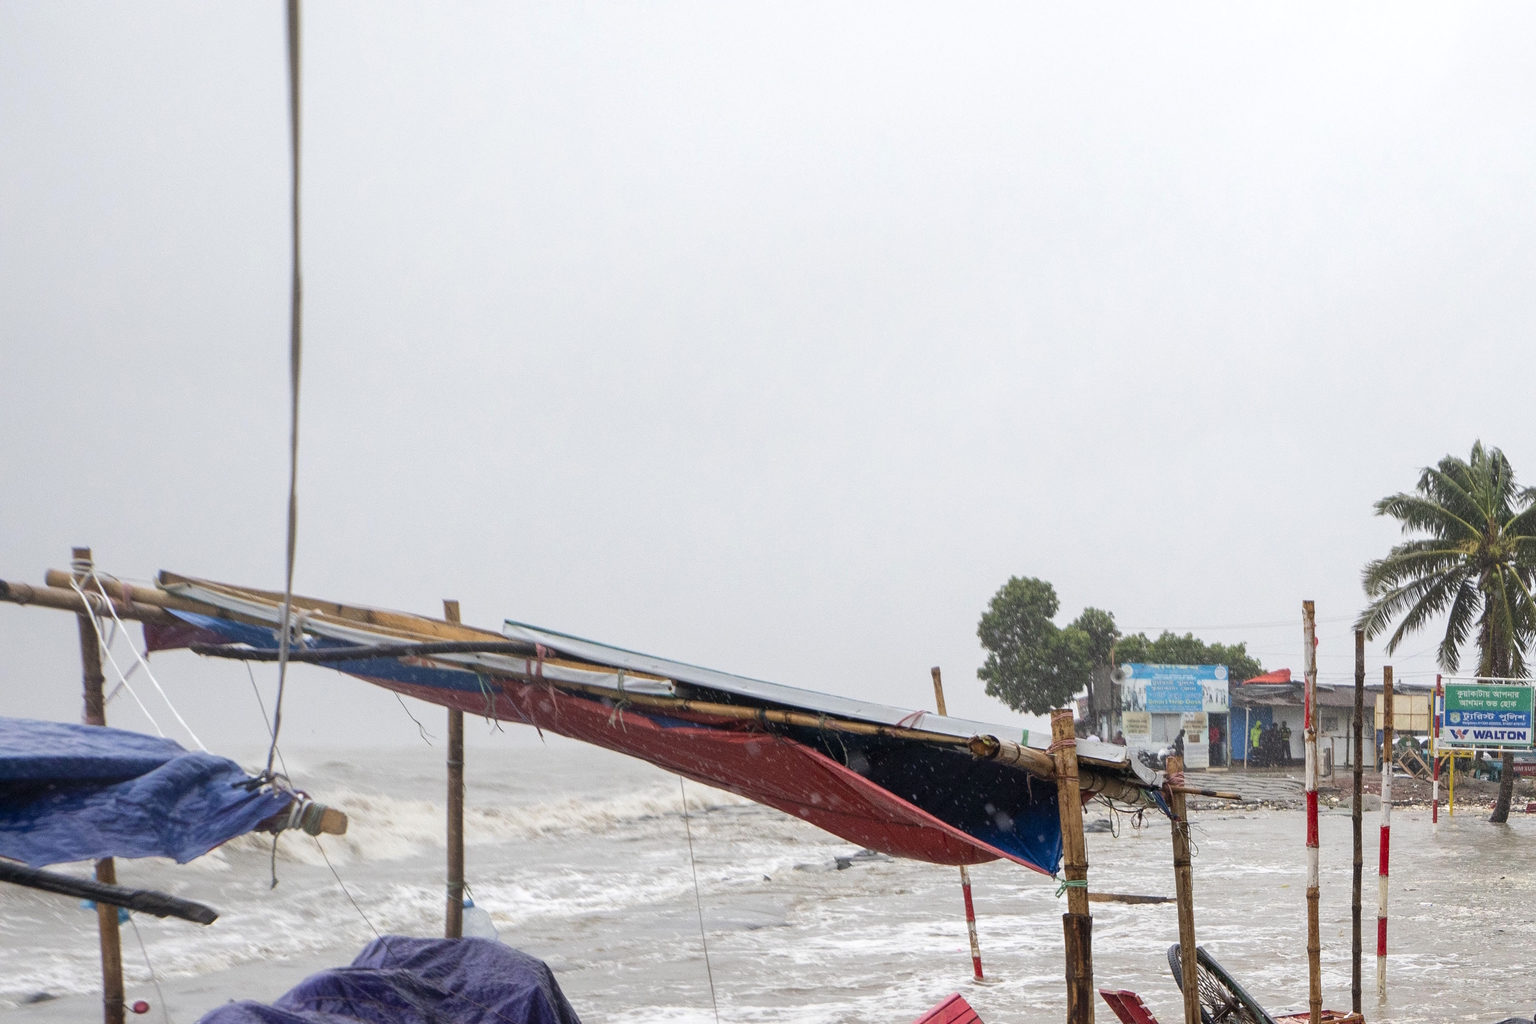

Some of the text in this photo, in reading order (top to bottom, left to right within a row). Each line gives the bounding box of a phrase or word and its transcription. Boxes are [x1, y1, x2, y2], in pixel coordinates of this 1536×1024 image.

[1492, 690, 1520, 699] আপনার
[1459, 699, 1484, 707] আগমন
[1500, 700, 1517, 708] হোক
[1462, 711, 1526, 722] ট্যুরিস্ট পুলিশ
[1473, 730, 1527, 740] WALTON
